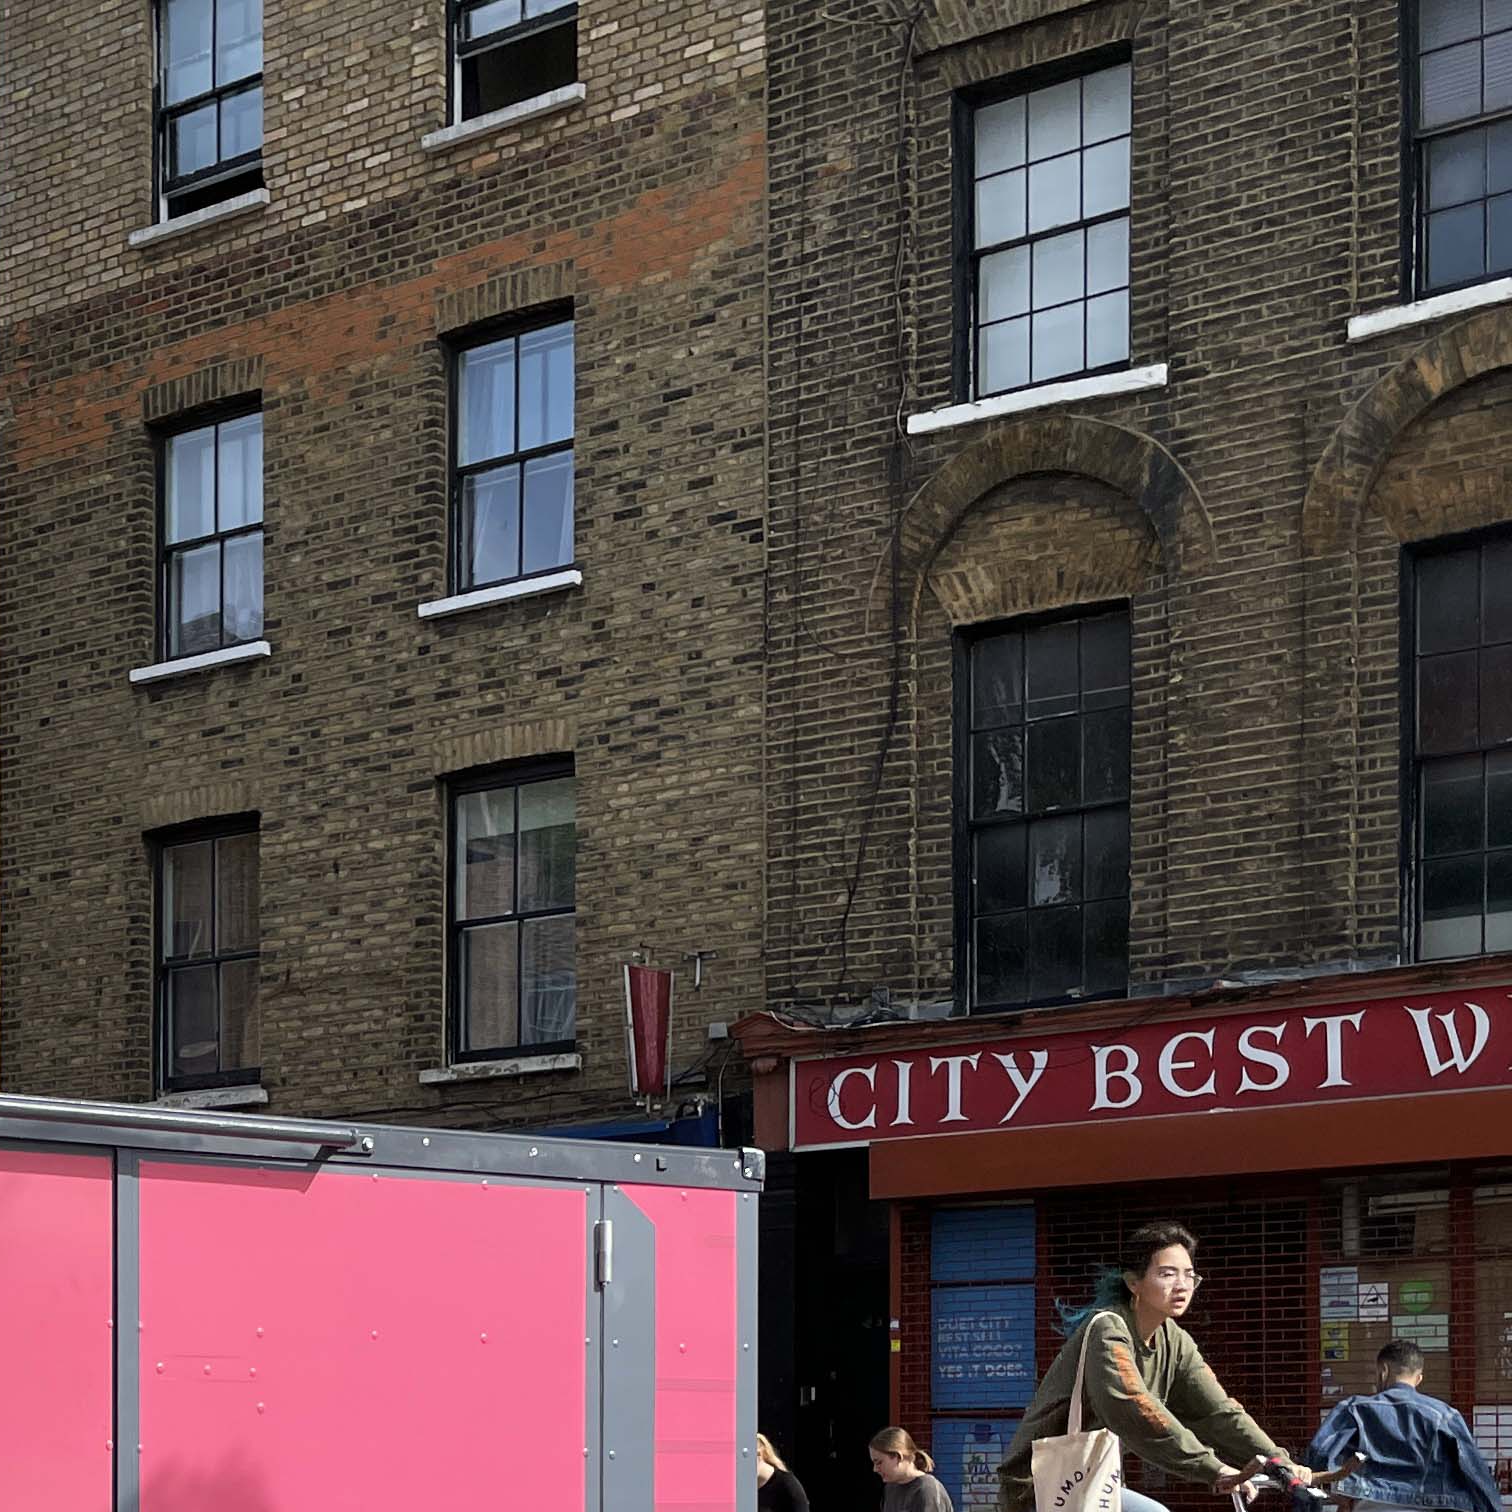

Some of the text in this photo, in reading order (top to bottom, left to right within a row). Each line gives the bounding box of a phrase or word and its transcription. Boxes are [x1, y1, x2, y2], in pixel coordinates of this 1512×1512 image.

[827, 994, 1512, 1129] CITY BEST W
[938, 1364, 963, 1378] YES
